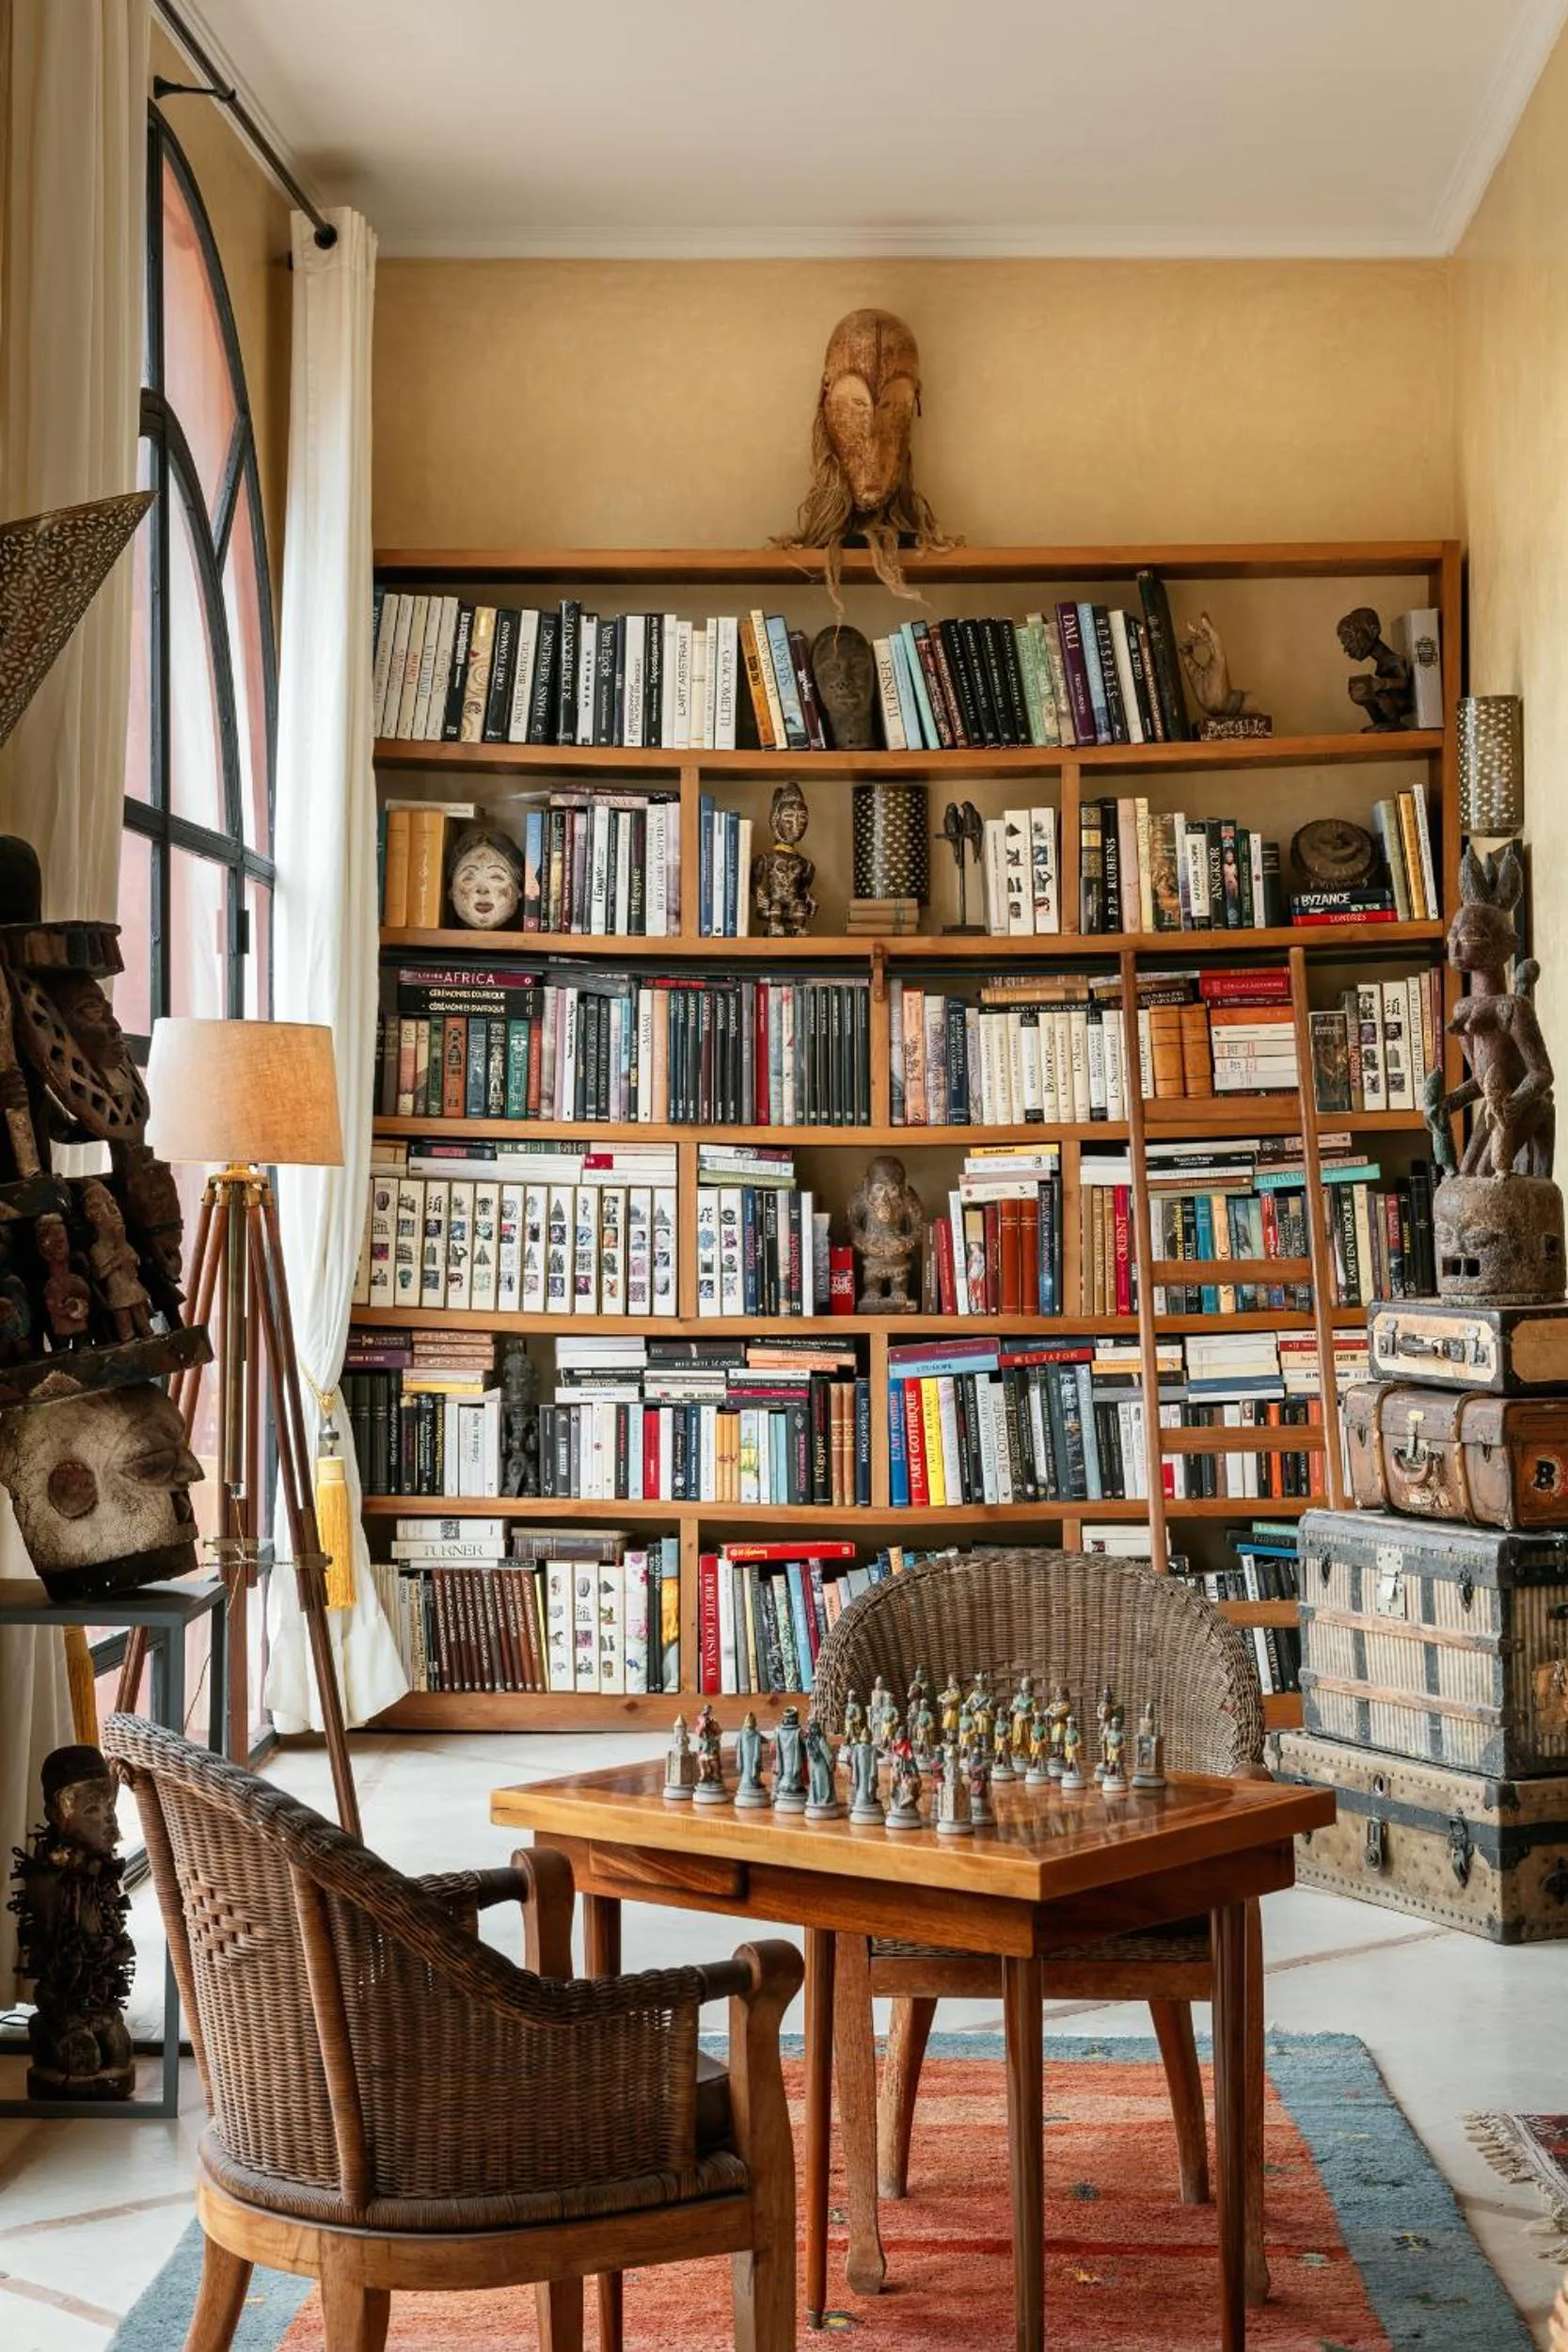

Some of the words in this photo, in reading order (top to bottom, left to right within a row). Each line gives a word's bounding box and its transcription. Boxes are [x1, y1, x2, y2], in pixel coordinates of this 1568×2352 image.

[540, 628, 555, 684] MEMLING
[678, 634, 689, 685] ABSTRAIT
[535, 686, 548, 717] HANS
[879, 659, 900, 718] TURNER
[1106, 836, 1117, 889] RUBENS
[1210, 847, 1223, 901] ANGKOR
[1301, 892, 1351, 906] BYZANCE
[443, 972, 495, 985] AFRICA
[1043, 1049, 1055, 1094] Byzance
[1117, 1215, 1129, 1262] ORIENT
[1342, 1199, 1355, 1242] TURQUIE
[1345, 1244, 1356, 1257] EN
[1346, 1258, 1358, 1284] L'ART
[905, 1391, 921, 1454] GOTHIQUE
[911, 1455, 923, 1488] L'ART
[425, 1543, 483, 1557] TURNER
[705, 1573, 716, 1619] ROBERT
